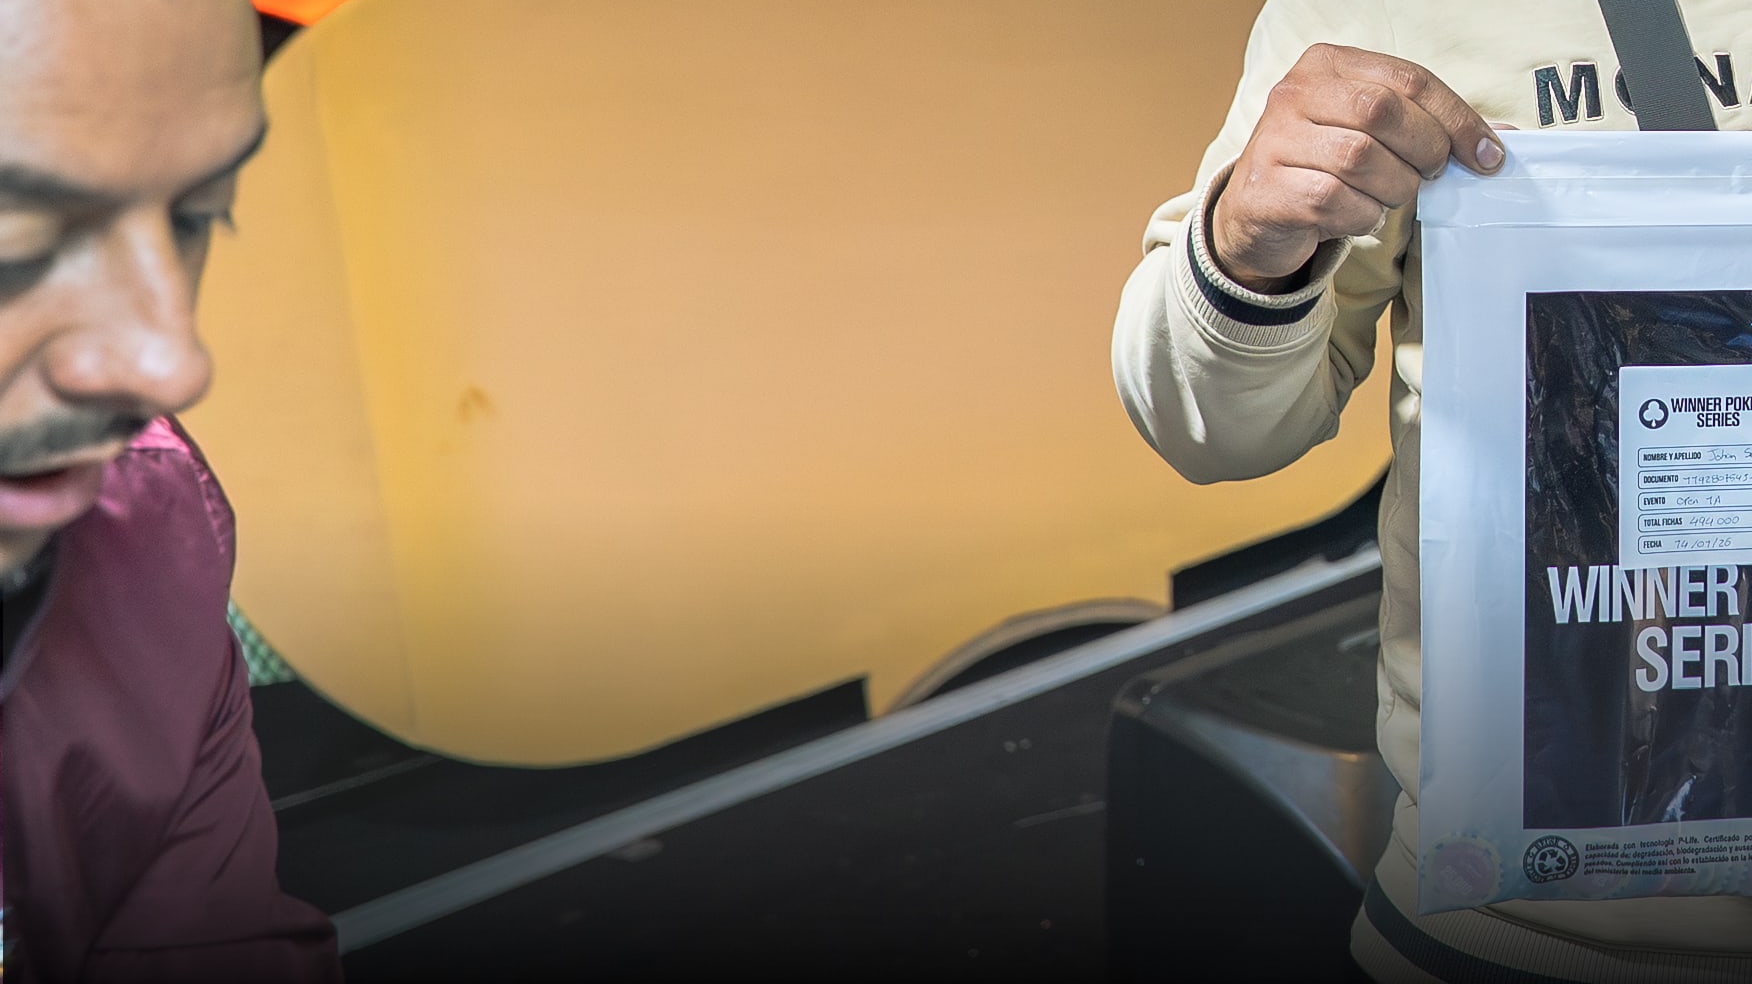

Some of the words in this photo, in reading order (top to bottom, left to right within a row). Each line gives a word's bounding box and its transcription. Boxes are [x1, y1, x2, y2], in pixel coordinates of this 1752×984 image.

[1671, 397, 1722, 414] WINNER
[1696, 412, 1740, 428] SERIES
[1643, 452, 1668, 461] NOMBRE
[1674, 451, 1702, 460] APELLIDO
[1643, 474, 1679, 484] DOCUMENTO
[1643, 496, 1666, 505] EVENTO
[1643, 518, 1661, 527] TOTAL
[1662, 517, 1683, 526] FICHAS
[1643, 540, 1662, 548] FECHA
[1547, 565, 1739, 624] WINNER
